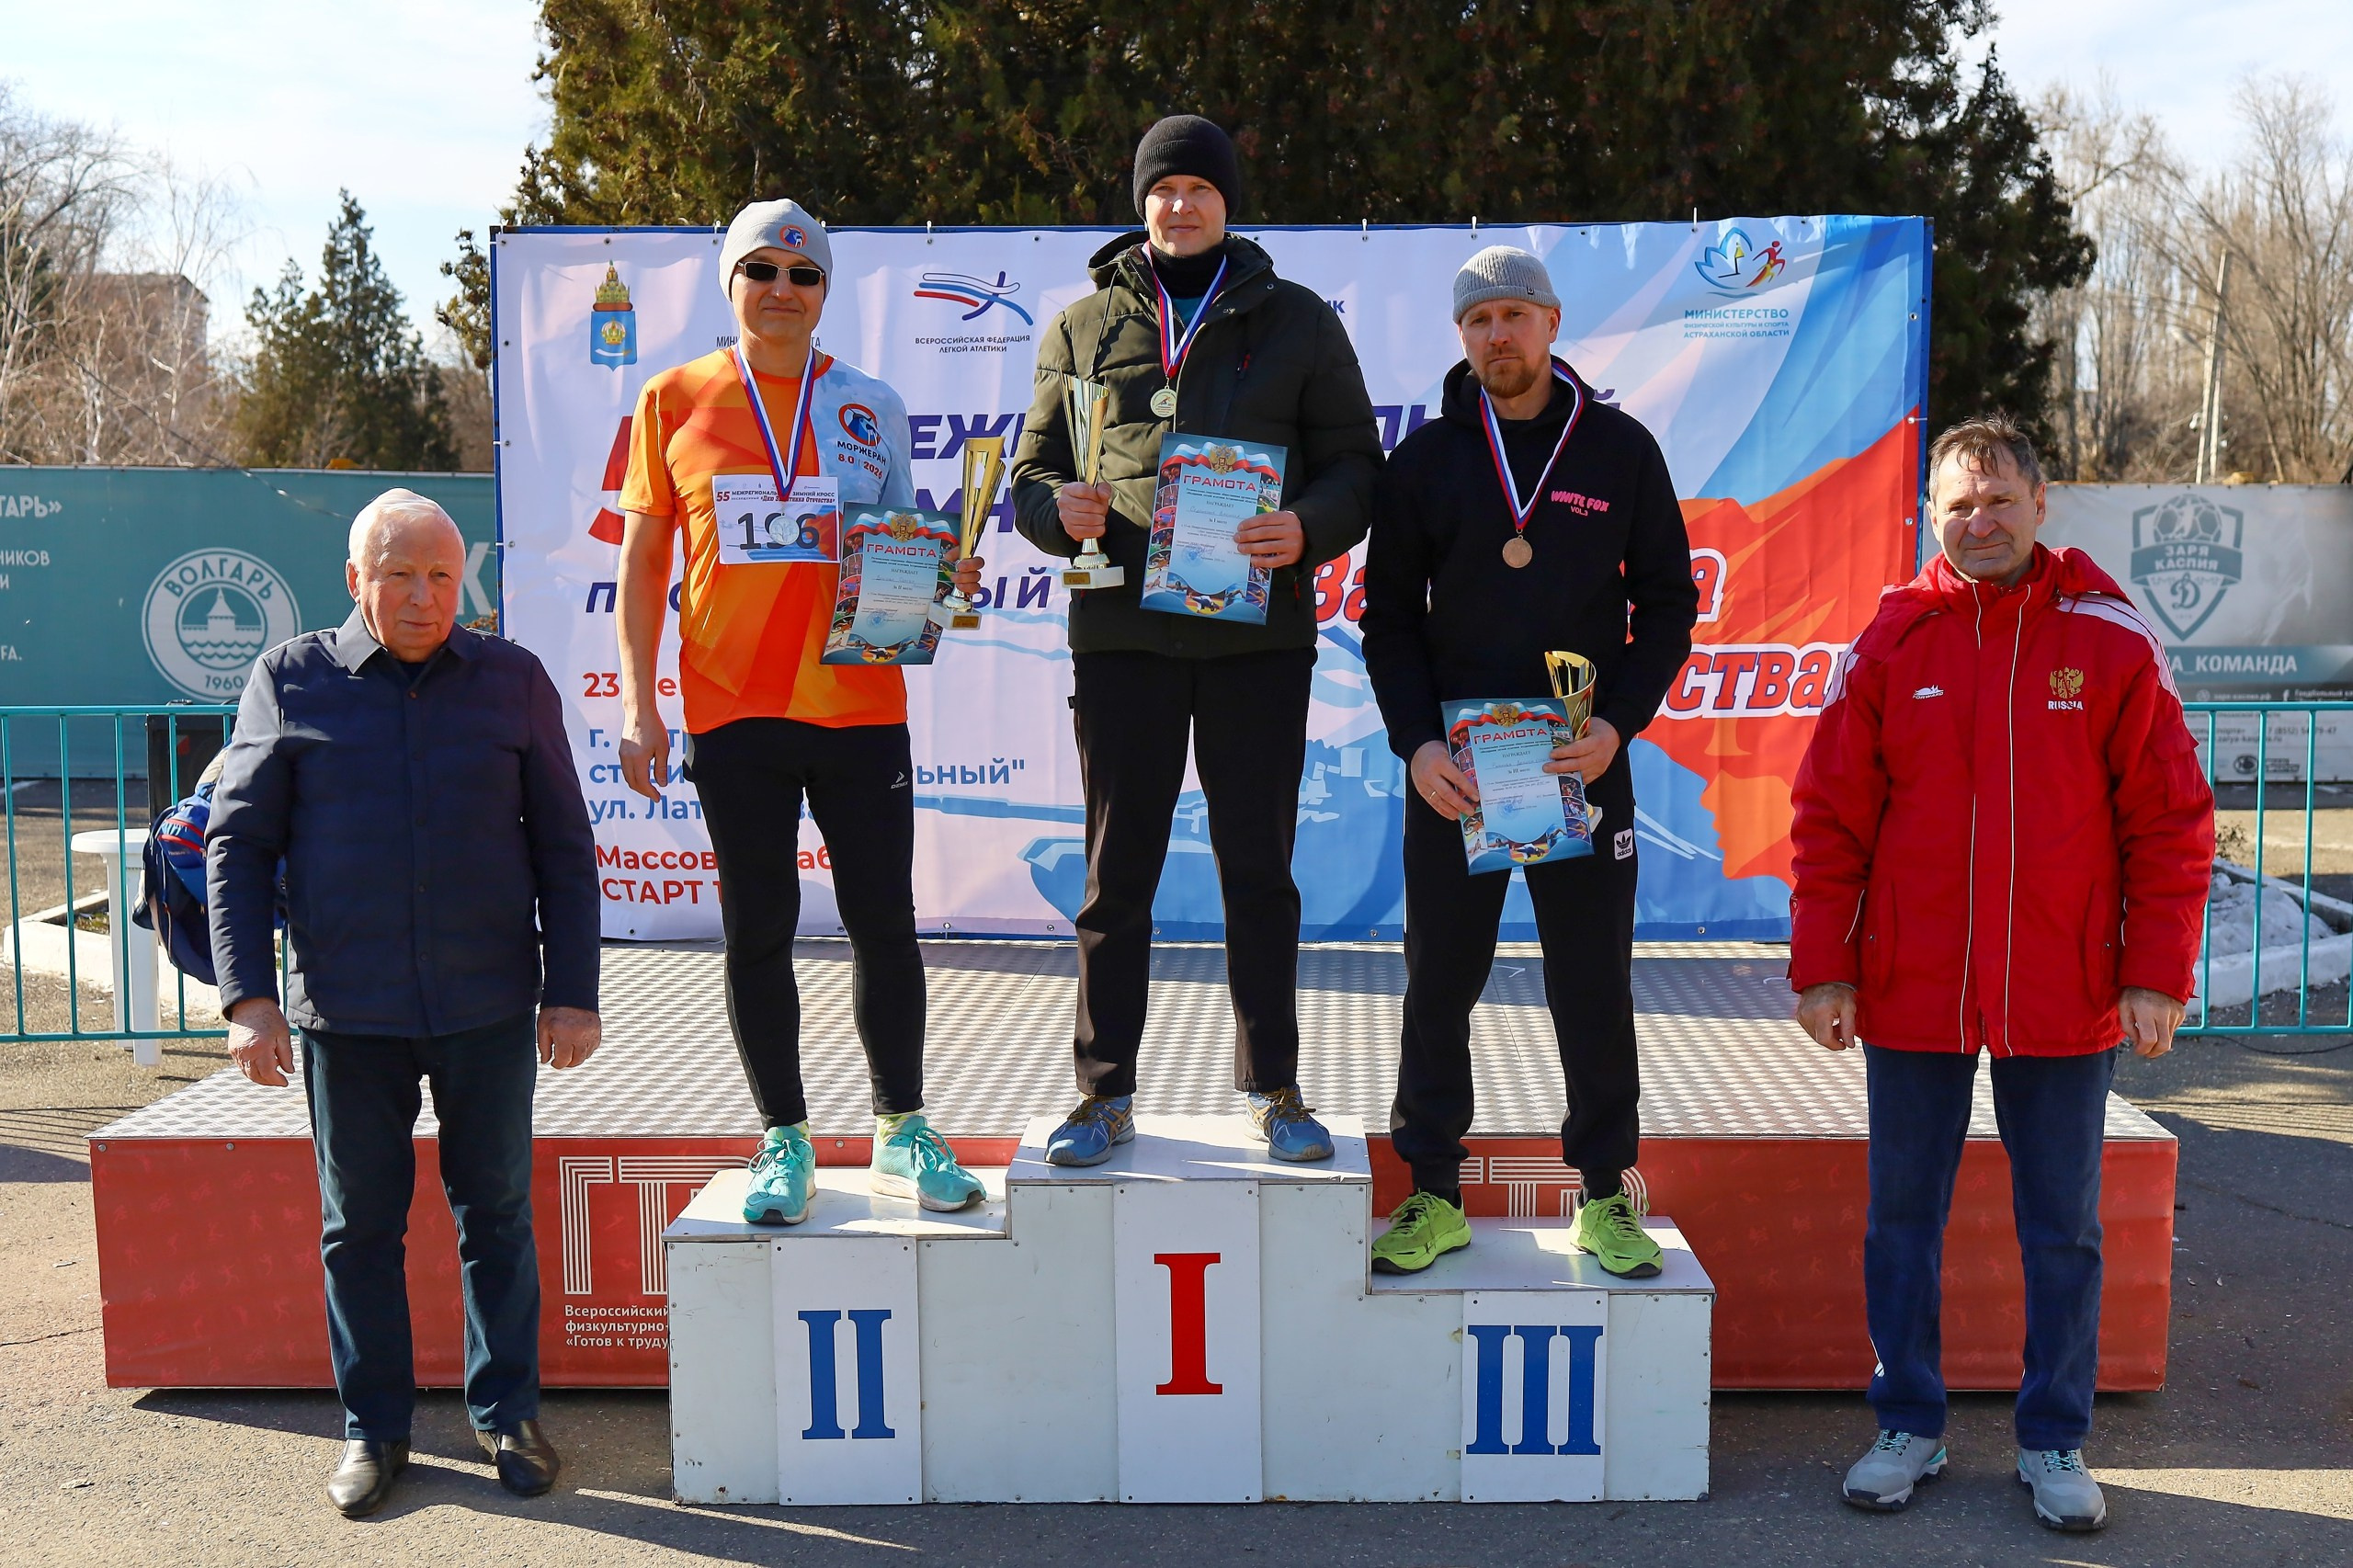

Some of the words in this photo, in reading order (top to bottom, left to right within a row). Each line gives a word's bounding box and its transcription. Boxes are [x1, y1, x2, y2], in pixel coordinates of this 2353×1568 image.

[1684, 308, 1789, 320] МИНИСТЕРСТВО
[915, 335, 984, 345] ВСЕРОССИЙСКАЯ
[986, 335, 1030, 344] ФЕДЕРАЦИЯ
[1684, 330, 1747, 339] АСТРАХАНСКОЙ
[1749, 329, 1790, 337] ОБЛАСТИ
[938, 345, 968, 354] ЛЕГКОЙ
[970, 345, 1007, 353] АТЛЕТИКИ
[837, 441, 886, 466] МОРЖЕРАН
[863, 460, 882, 479] 2026
[1184, 475, 1256, 492] ГРАМОТА
[716, 491, 731, 502] 55
[1551, 490, 1586, 507] WHITE
[1586, 497, 1609, 512] FOX
[867, 543, 937, 558] ГРАМОТА
[2165, 544, 2210, 557] ЗАРЯ
[2154, 557, 2219, 571] КАСПИЯ
[164, 557, 274, 600] ВОЛГАРЬ
[2170, 655, 2298, 676] А_КОМАНДА
[205, 675, 244, 690] 1960
[583, 673, 620, 698] 23
[2048, 700, 2084, 710] RUSSIA
[589, 729, 610, 747] г.
[1473, 728, 1547, 744] ГРАМОТА
[588, 800, 634, 824] ул.
[1617, 848, 1631, 857] adidas
[601, 879, 703, 904] СТАРТ
[1154, 1253, 1223, 1395] I
[566, 1335, 612, 1346] «Готов
[617, 1338, 624, 1346] к
[629, 1338, 668, 1349] труду
[798, 1309, 895, 1440] II
[1466, 1324, 1604, 1456] III
